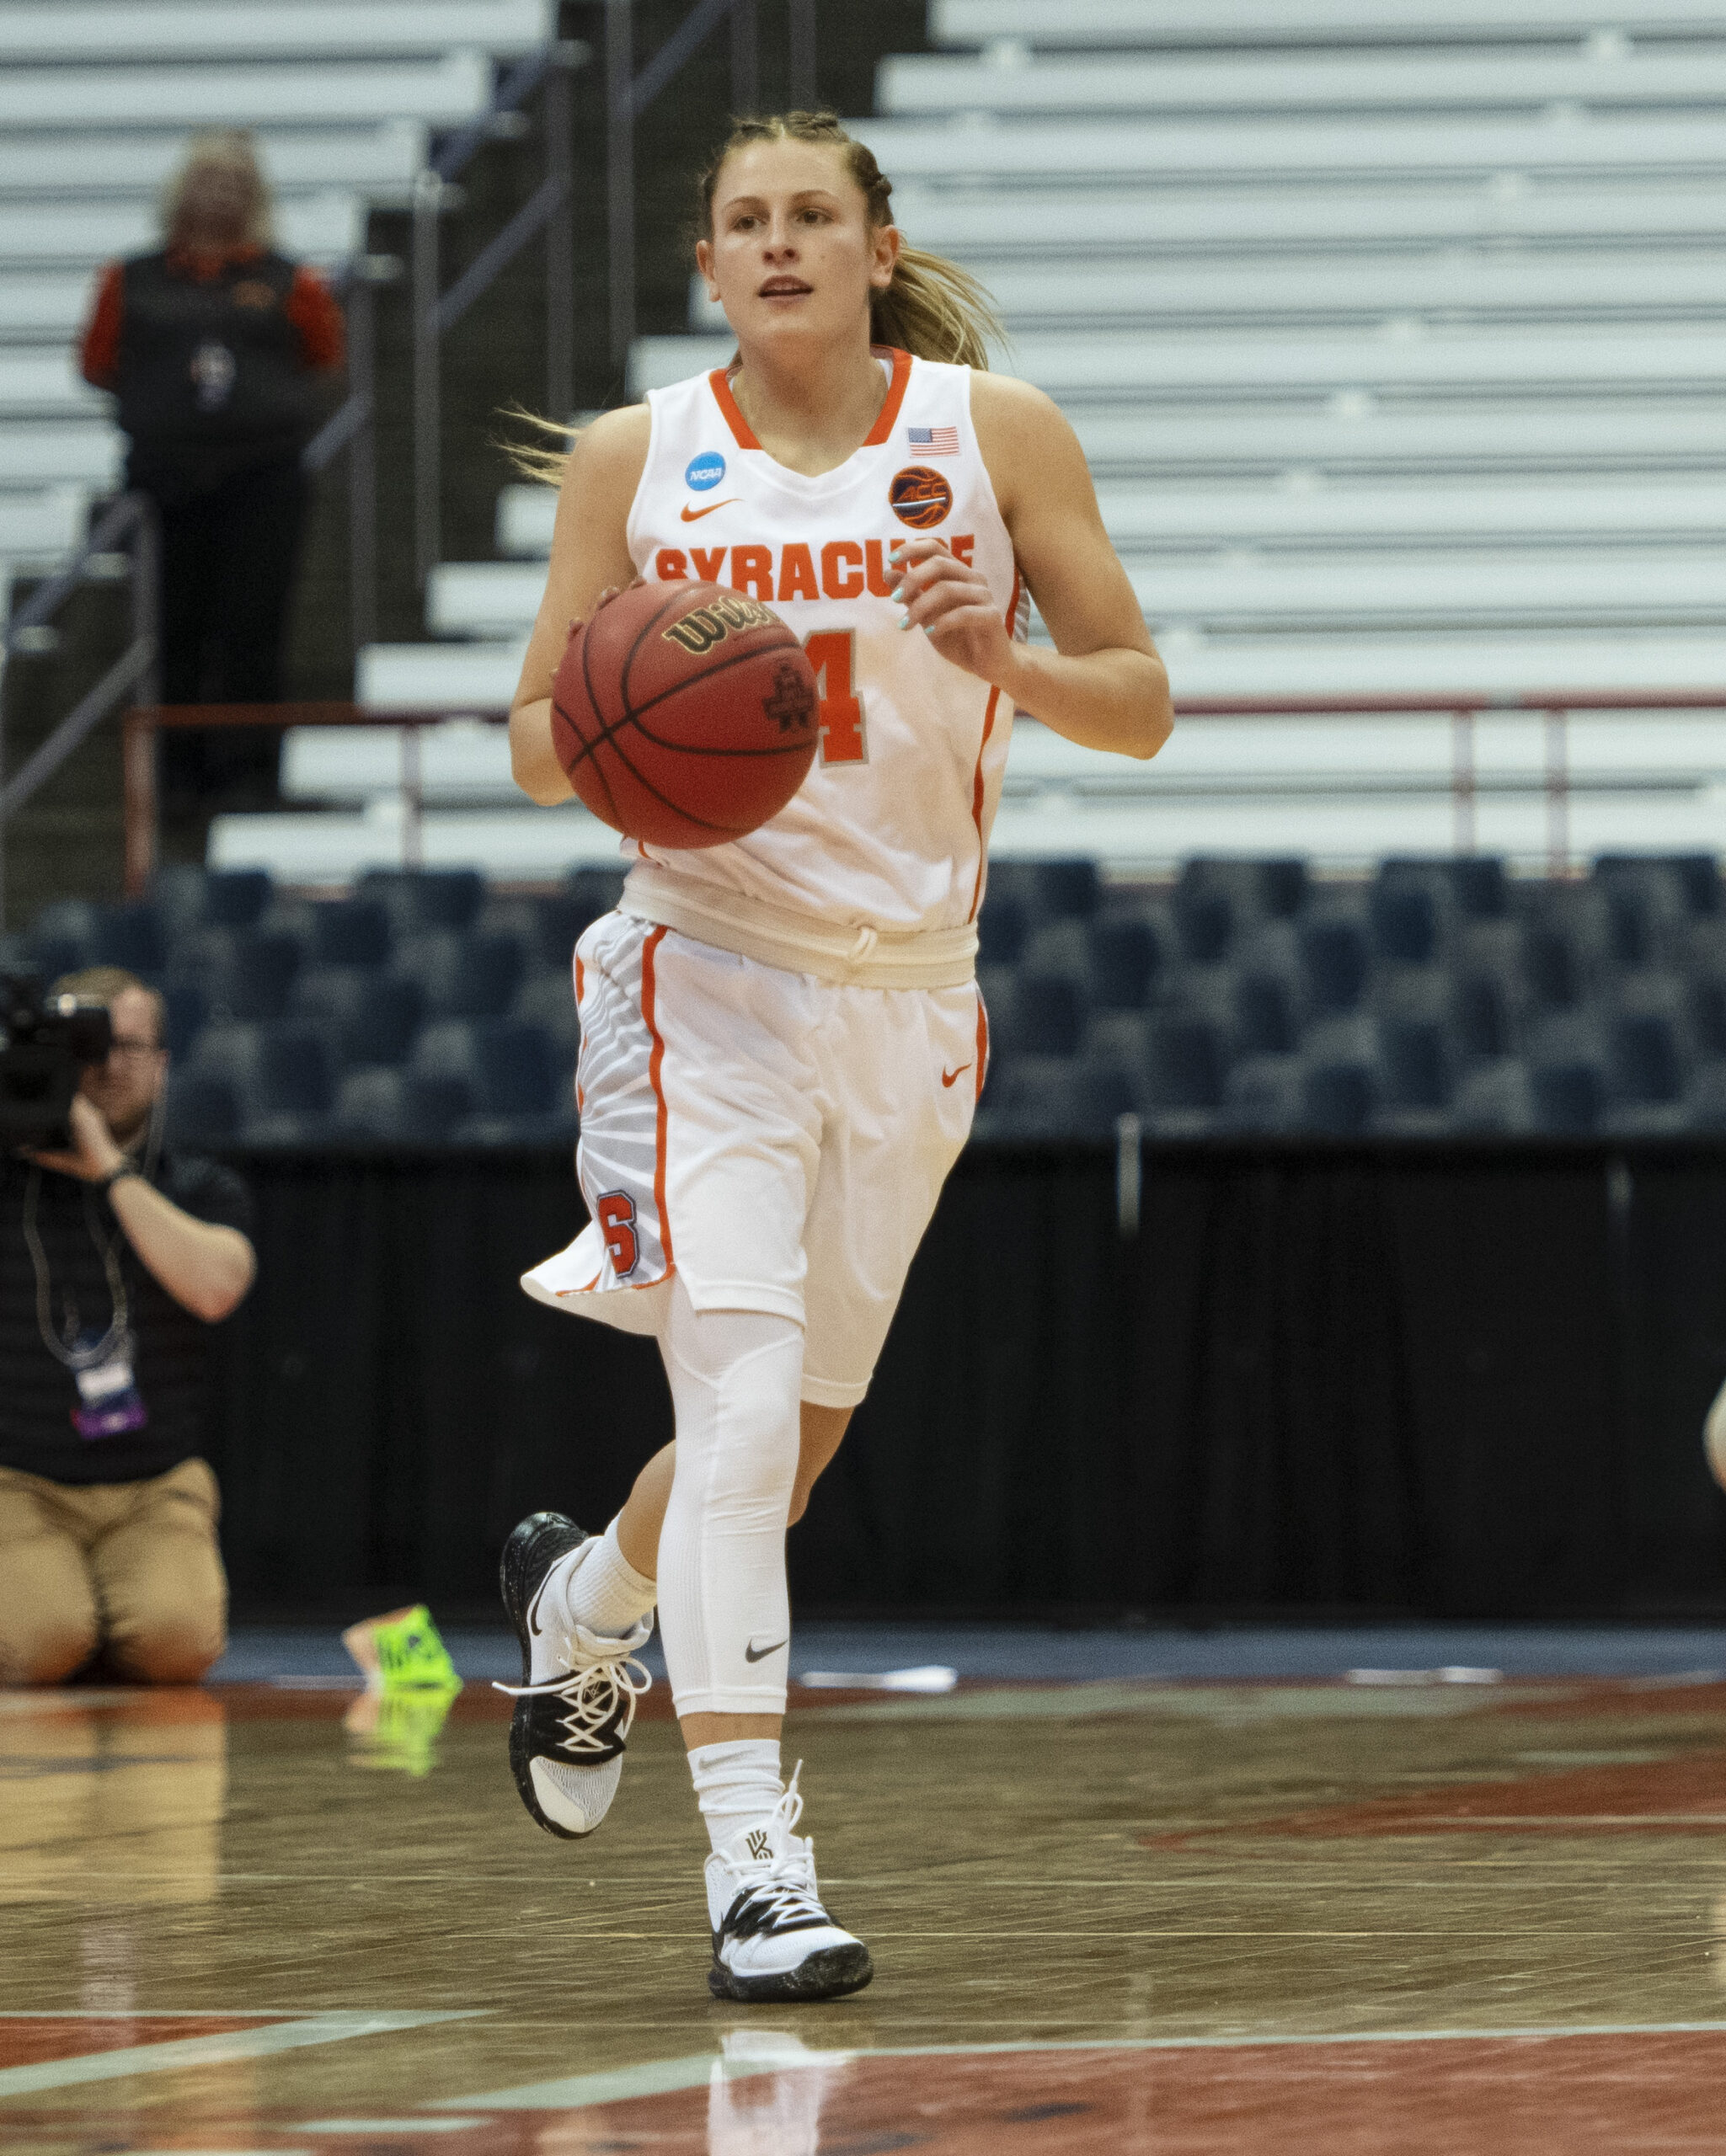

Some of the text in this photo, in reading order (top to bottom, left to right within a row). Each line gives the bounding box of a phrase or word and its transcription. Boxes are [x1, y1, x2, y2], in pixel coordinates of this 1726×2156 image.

[690, 467, 722, 480] NCAA
[896, 481, 947, 503] ACC
[655, 533, 975, 600] SYRACU
